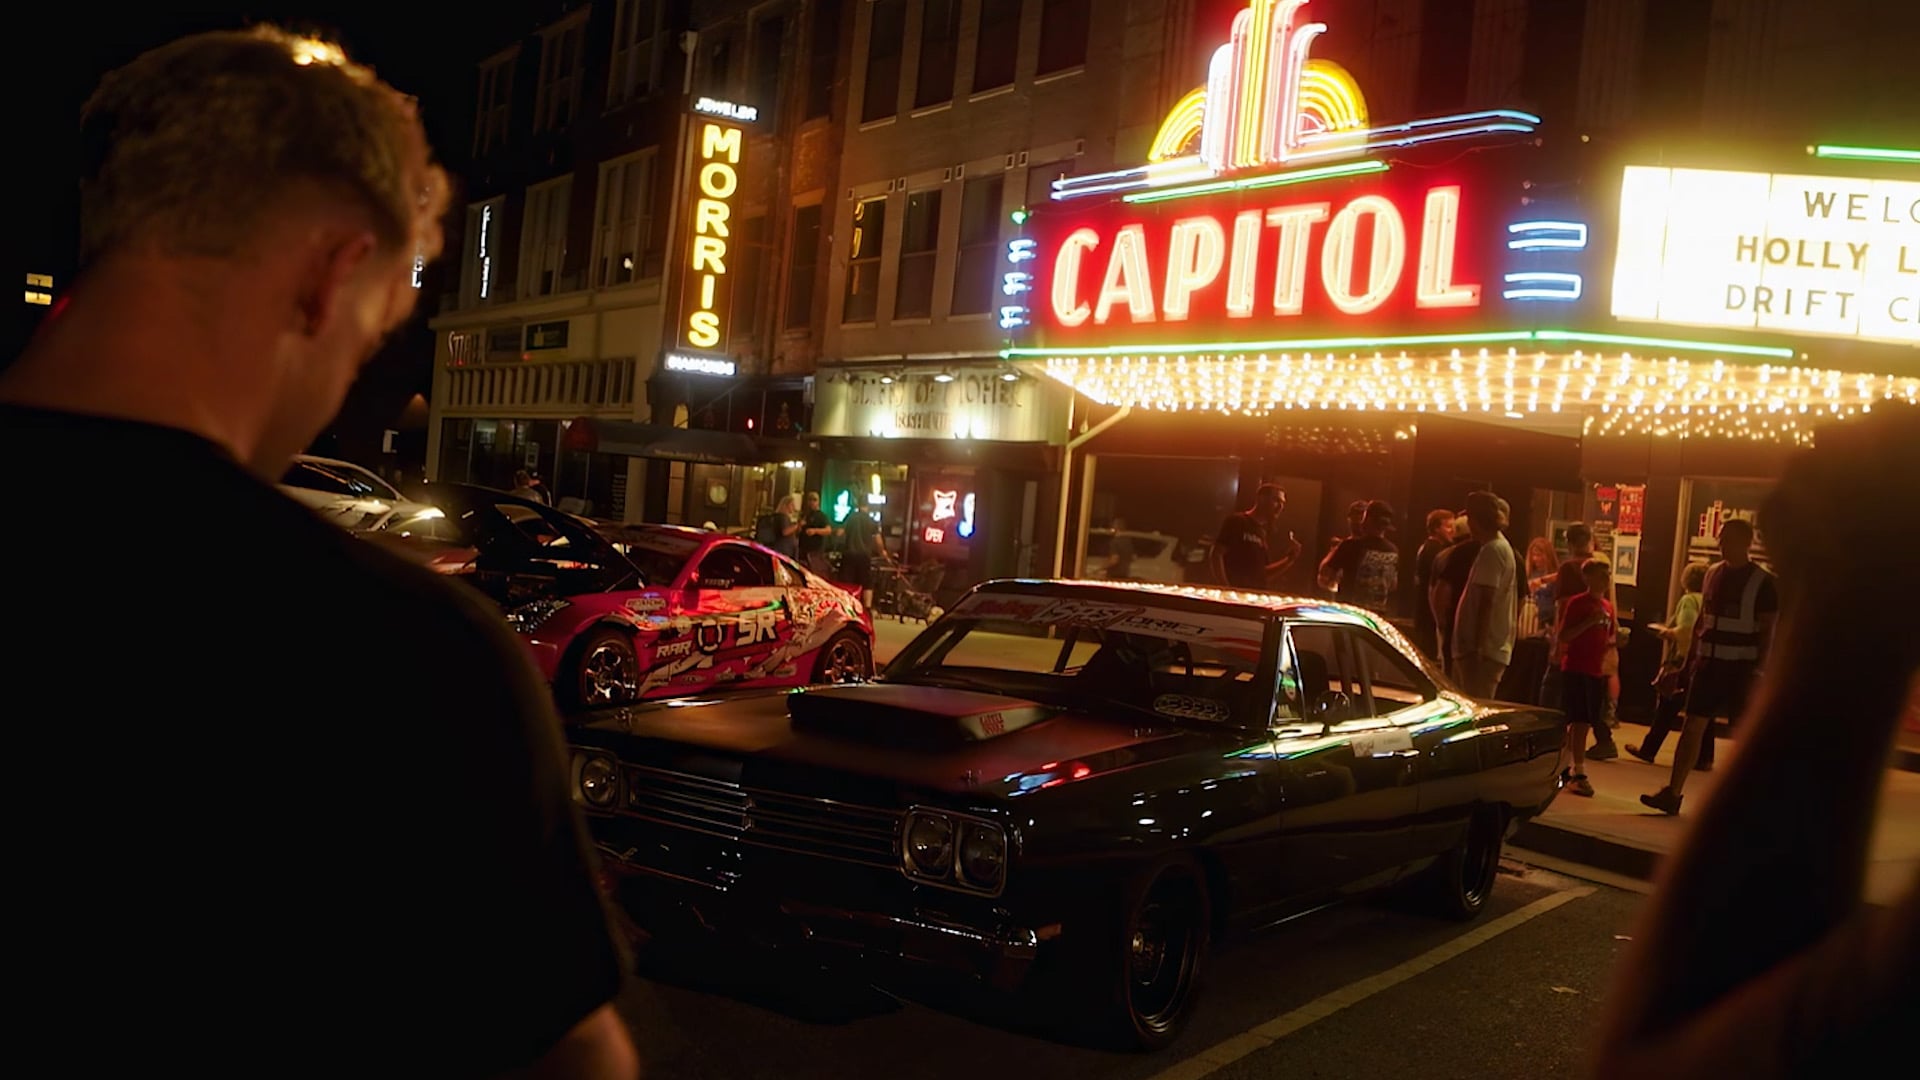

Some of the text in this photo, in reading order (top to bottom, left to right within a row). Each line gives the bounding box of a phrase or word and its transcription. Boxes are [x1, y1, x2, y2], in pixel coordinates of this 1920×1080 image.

[687, 124, 742, 348] MORRIS
[1051, 186, 1481, 328] CAPITOL
[1736, 236, 1869, 271] HOLLY
[1726, 284, 1920, 325] DRIFT C
